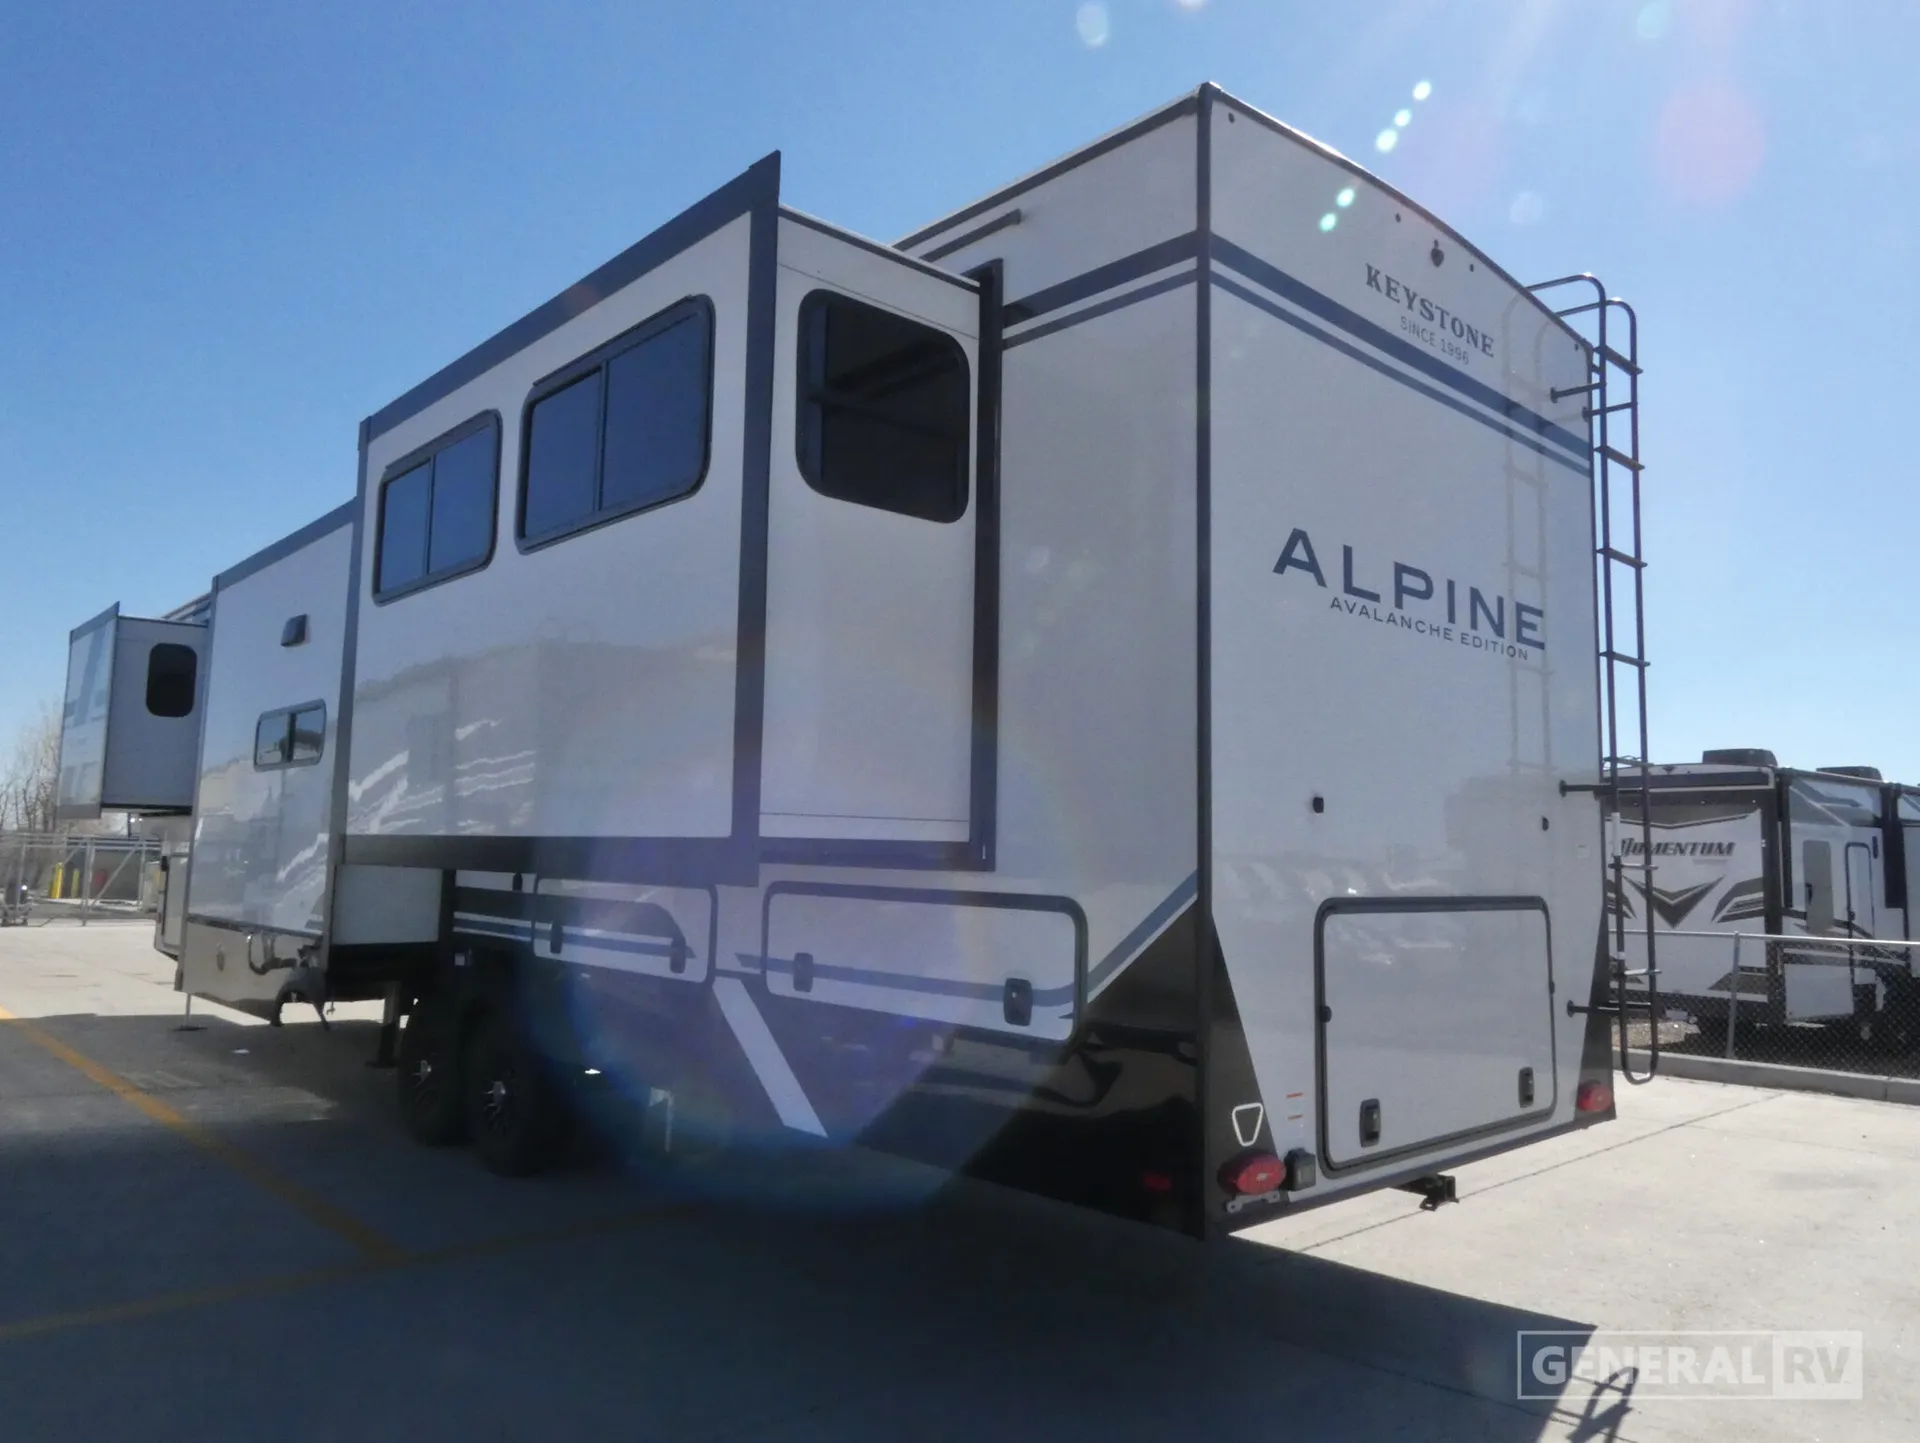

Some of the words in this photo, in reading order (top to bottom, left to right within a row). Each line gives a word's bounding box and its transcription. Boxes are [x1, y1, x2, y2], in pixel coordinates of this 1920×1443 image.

[1365, 262, 1494, 358] KEYSTONE
[1400, 315, 1436, 347] SINCE
[1440, 338, 1469, 365] 1996
[1272, 528, 1546, 650] ALPINE
[1329, 596, 1453, 641] AVALANCHE
[1460, 632, 1529, 660] EDITION
